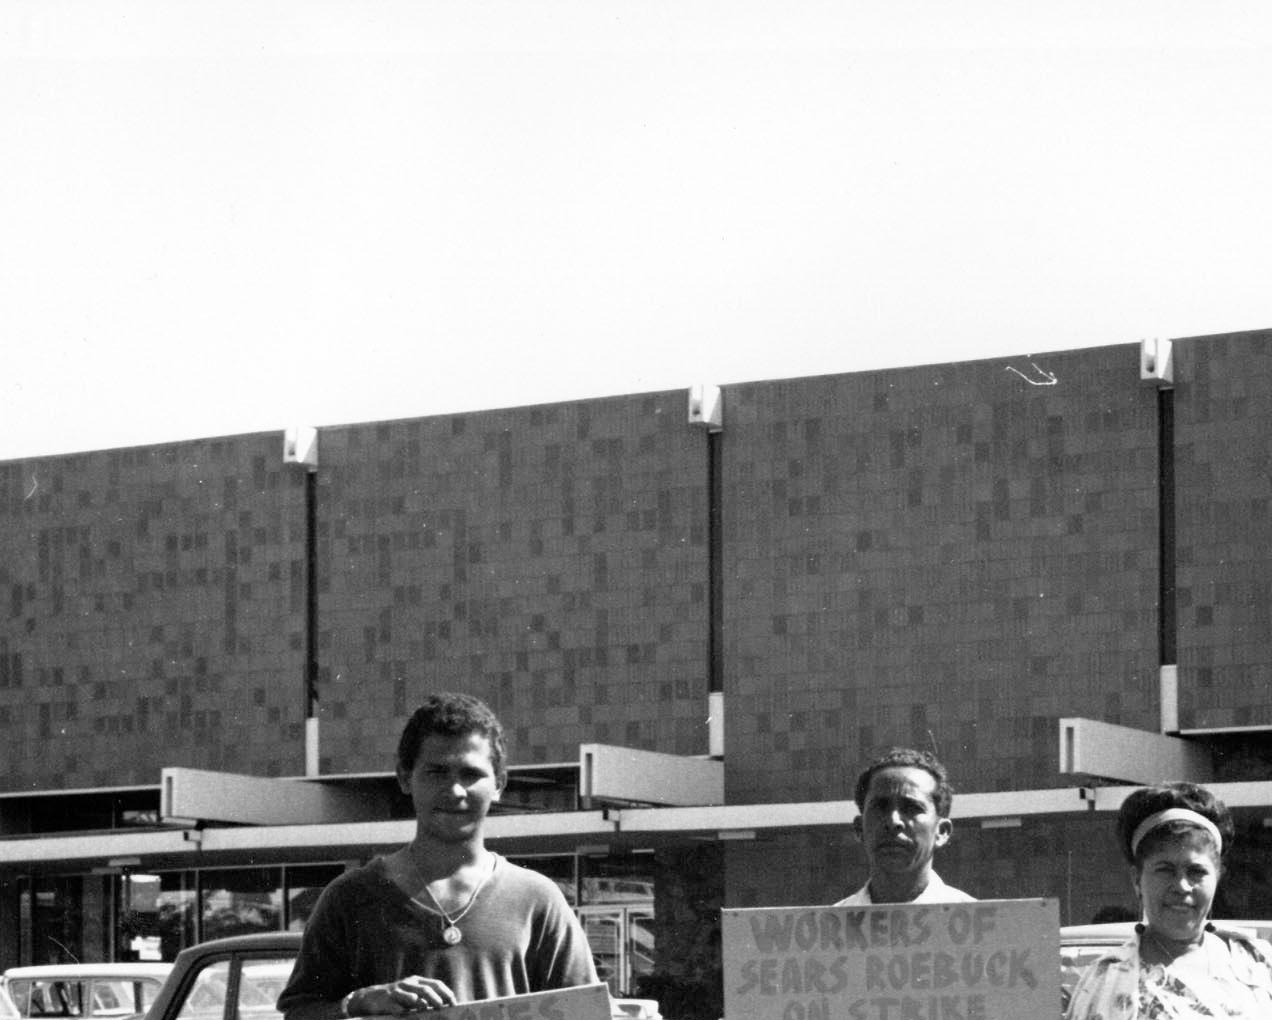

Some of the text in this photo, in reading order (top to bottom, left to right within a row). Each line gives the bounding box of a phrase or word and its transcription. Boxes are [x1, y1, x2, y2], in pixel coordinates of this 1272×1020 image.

[750, 907, 997, 952] WORKERS OF
[737, 949, 1039, 995] SEARS ROEBUCK
